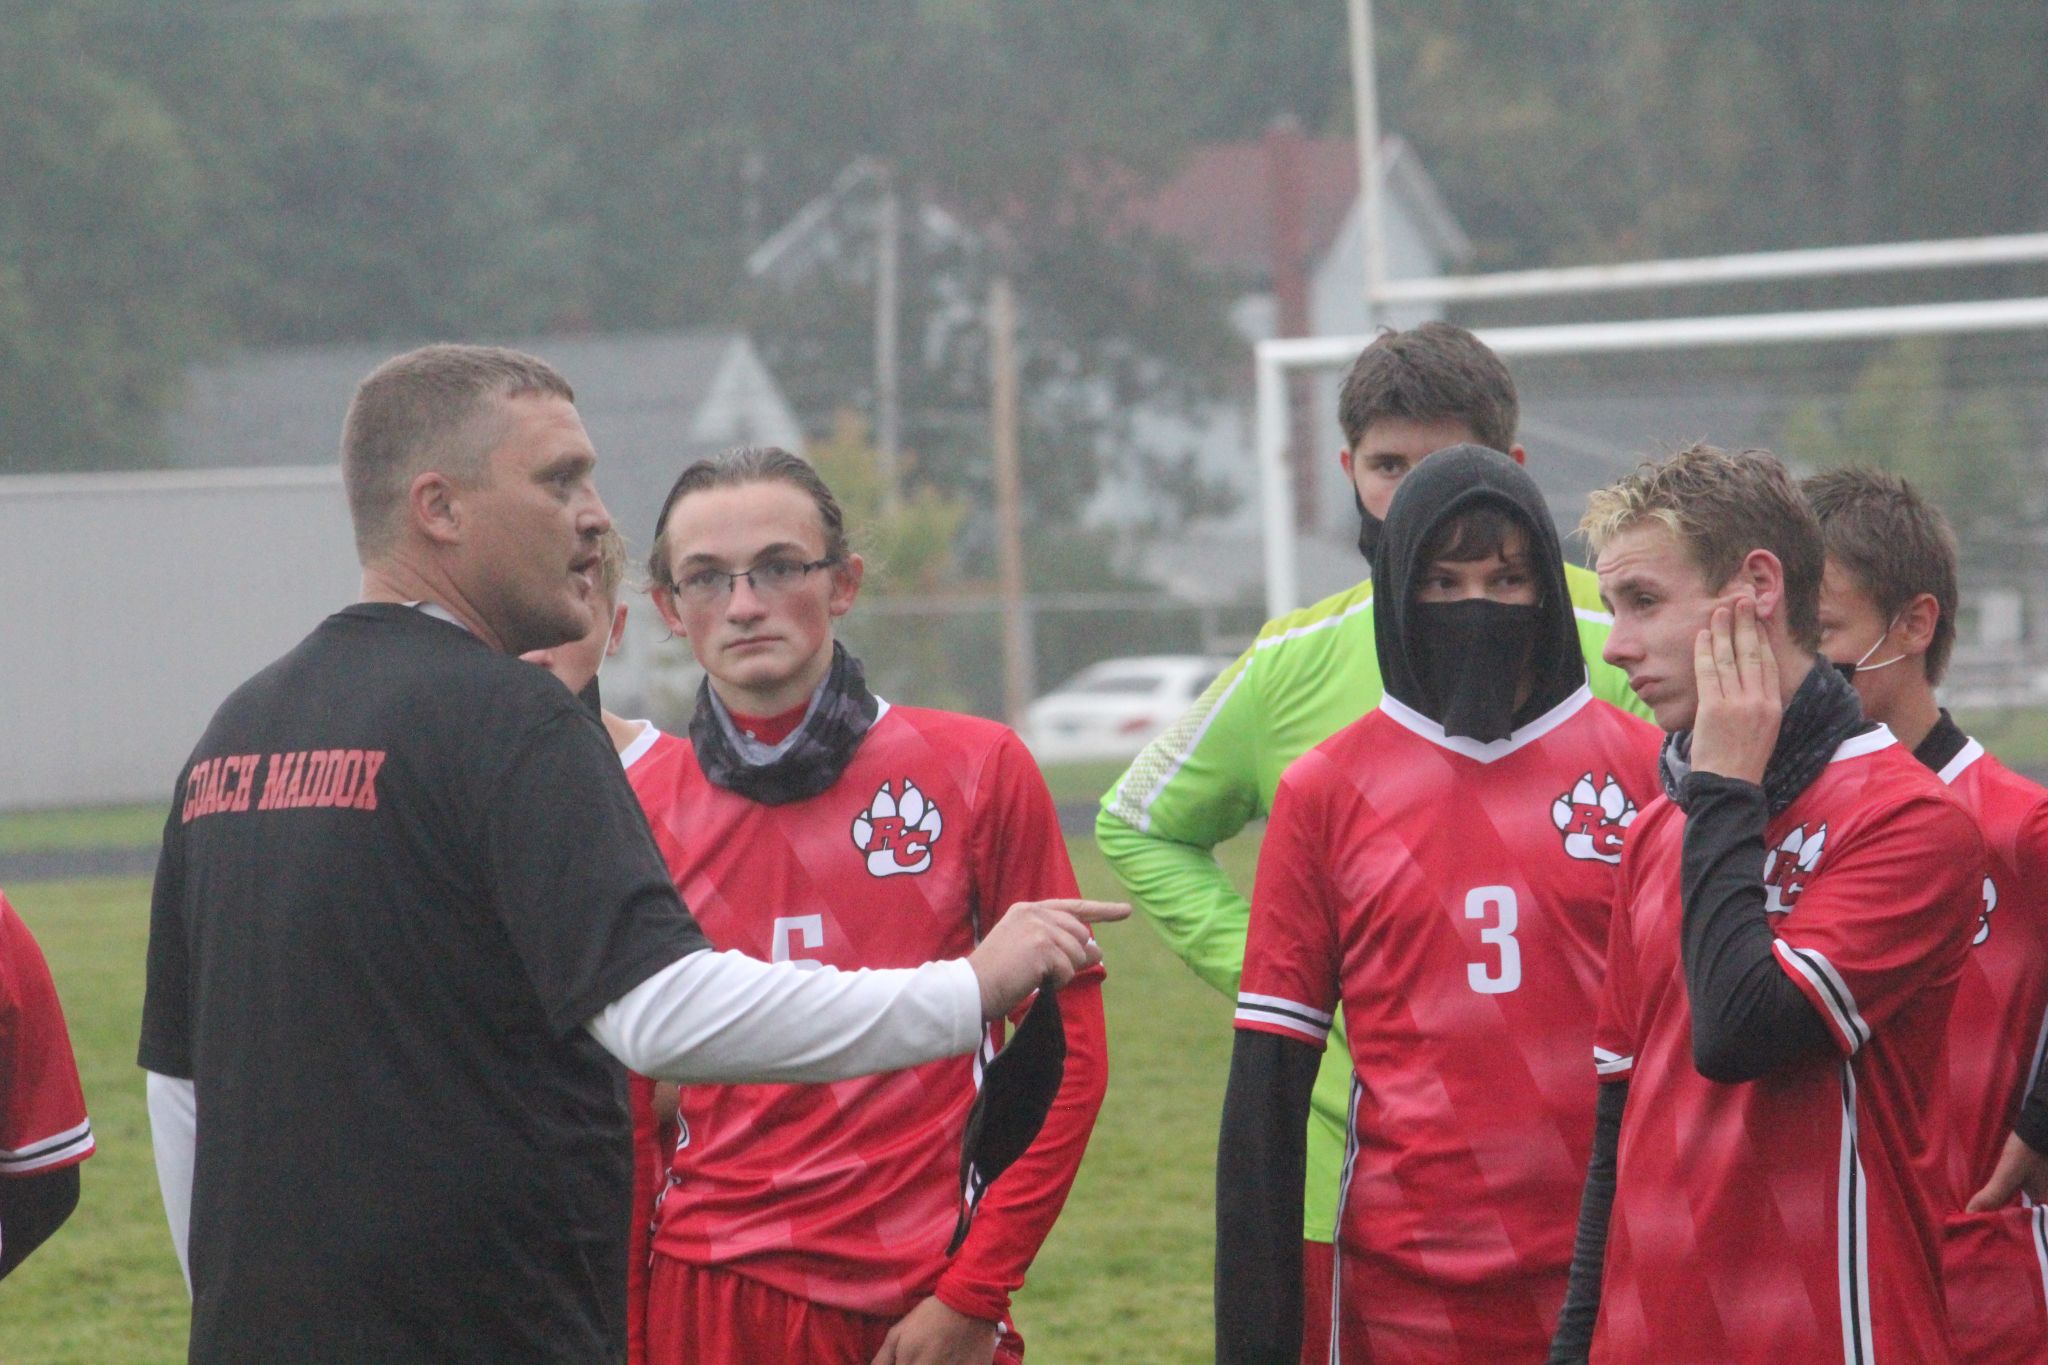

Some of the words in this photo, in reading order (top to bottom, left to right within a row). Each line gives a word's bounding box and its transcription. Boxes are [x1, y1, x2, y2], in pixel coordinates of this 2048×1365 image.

[182, 754, 261, 824] COACH
[257, 749, 386, 811] MADDOX
[865, 815, 933, 868] RC
[1564, 803, 1629, 856] RC
[1464, 884, 1522, 994] 3
